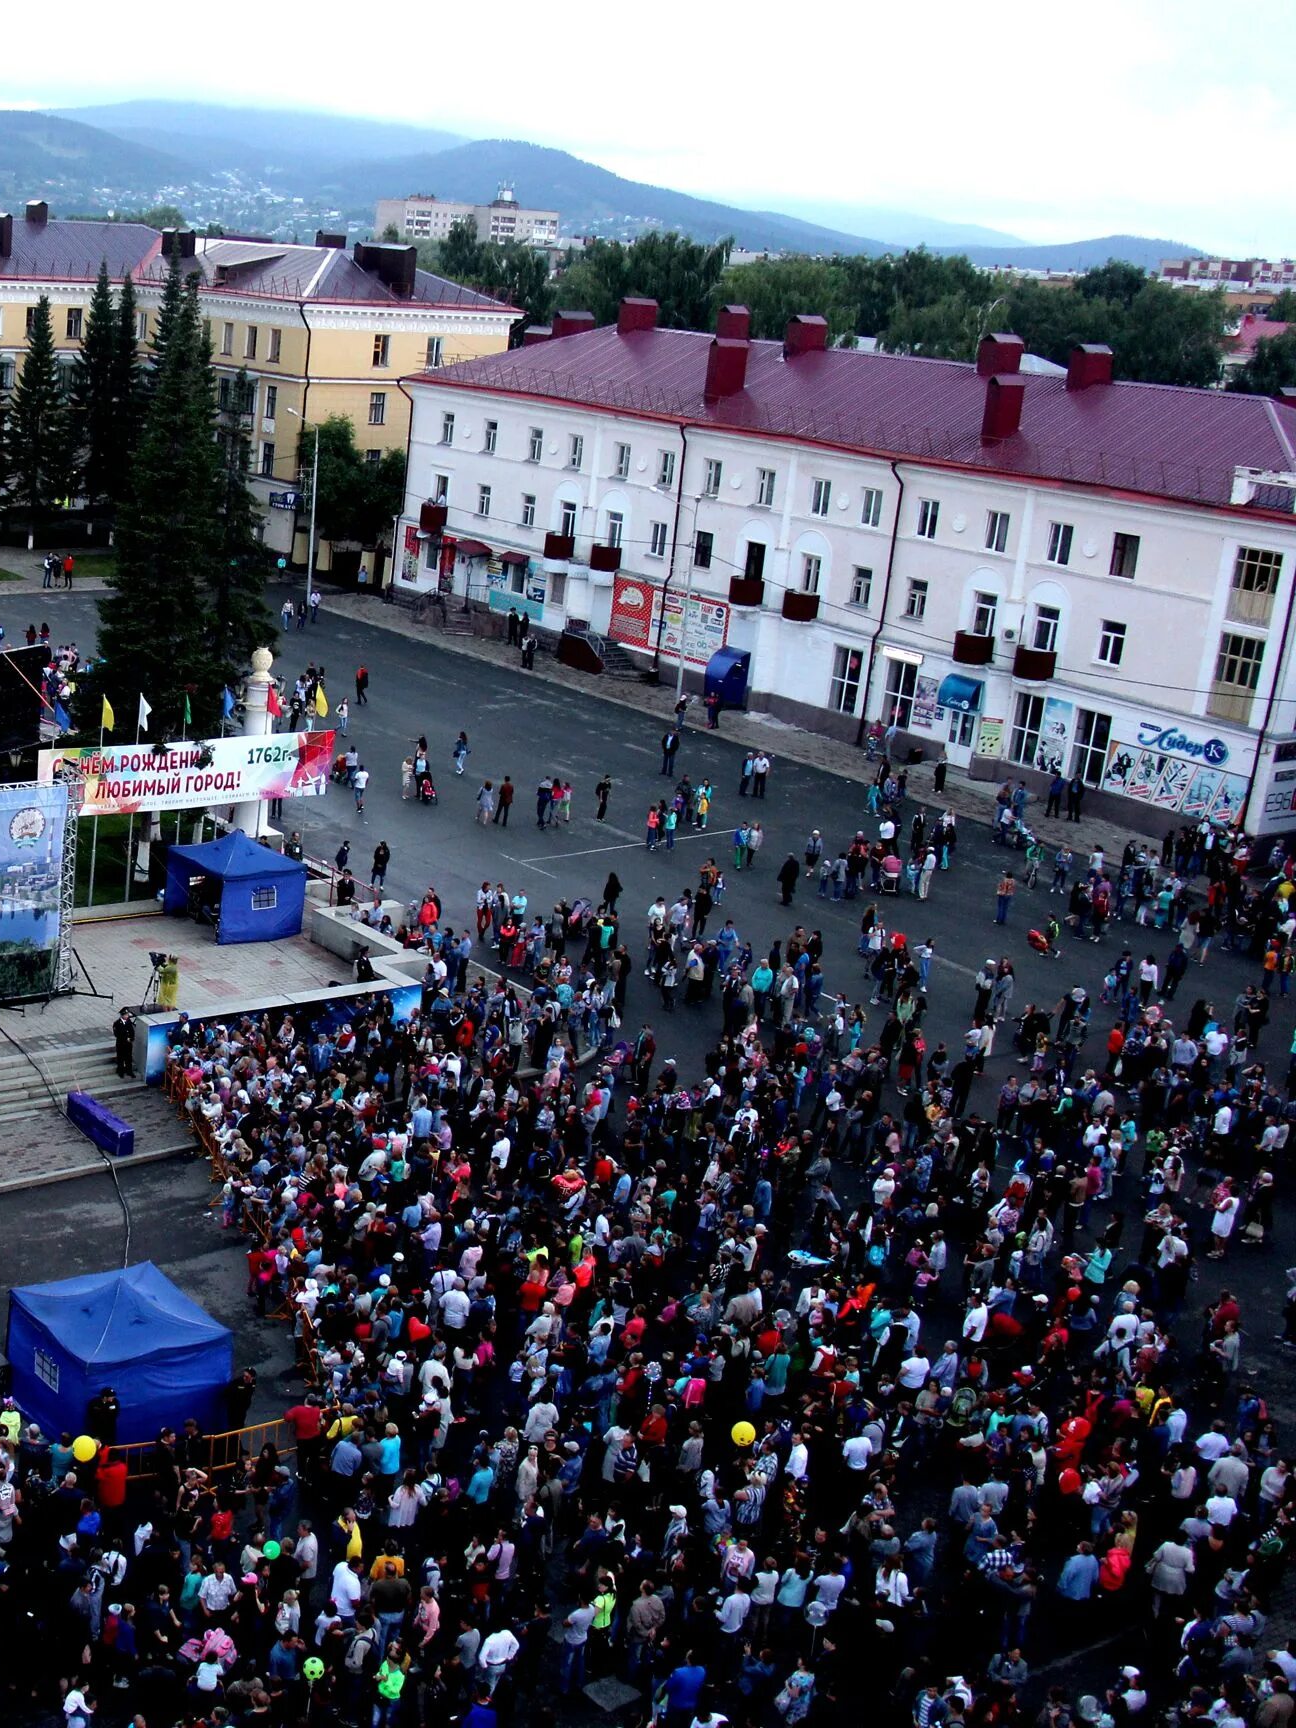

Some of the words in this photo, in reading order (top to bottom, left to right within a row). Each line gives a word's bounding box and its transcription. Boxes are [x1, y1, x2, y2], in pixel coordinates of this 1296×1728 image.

[67, 752, 115, 777] НЁМ
[120, 750, 214, 775] РОЖДЕНИ,
[95, 773, 181, 799] ЛЮБИМЫЙ
[185, 772, 241, 793] ГОРОД!
